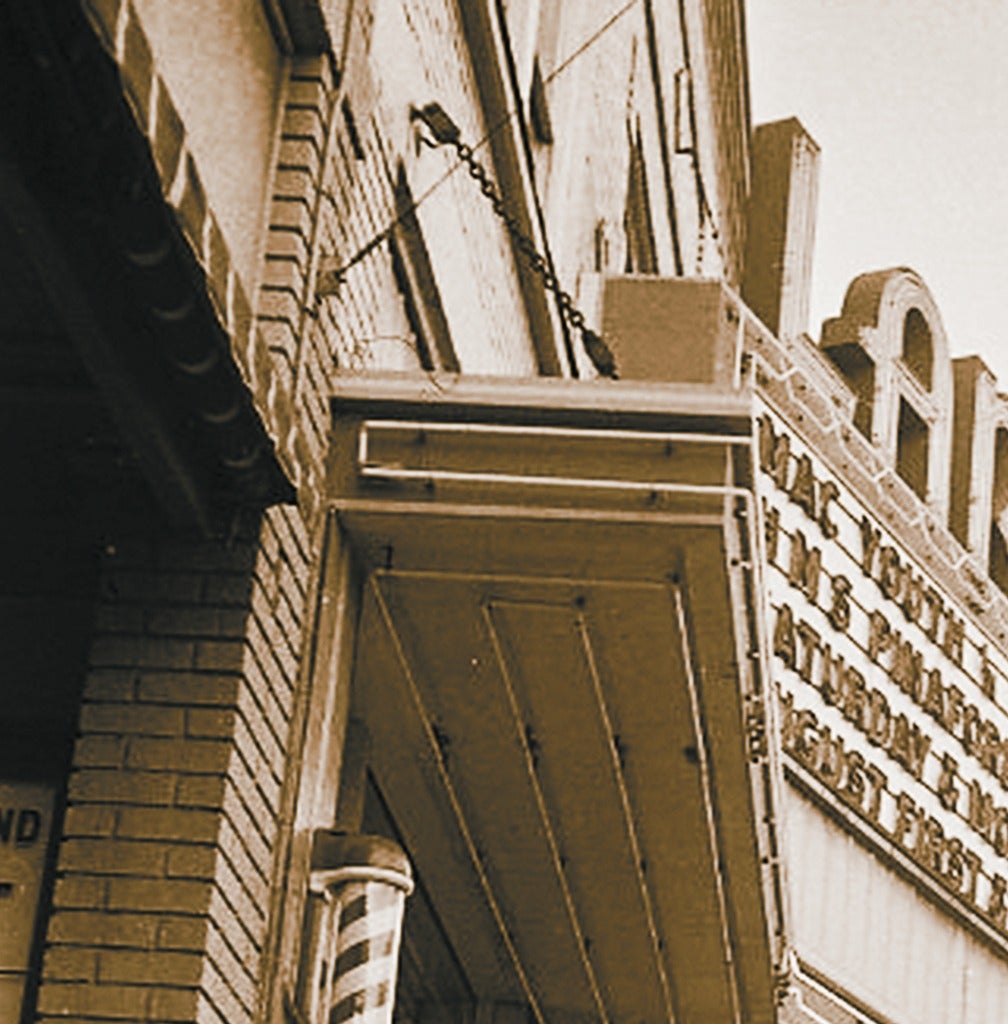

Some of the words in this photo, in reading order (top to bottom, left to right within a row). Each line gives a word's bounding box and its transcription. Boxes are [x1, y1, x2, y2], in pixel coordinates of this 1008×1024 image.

[861, 514, 966, 669] YOUTH
[769, 602, 931, 781] ATURDAY
[775, 681, 888, 825] UGUST
